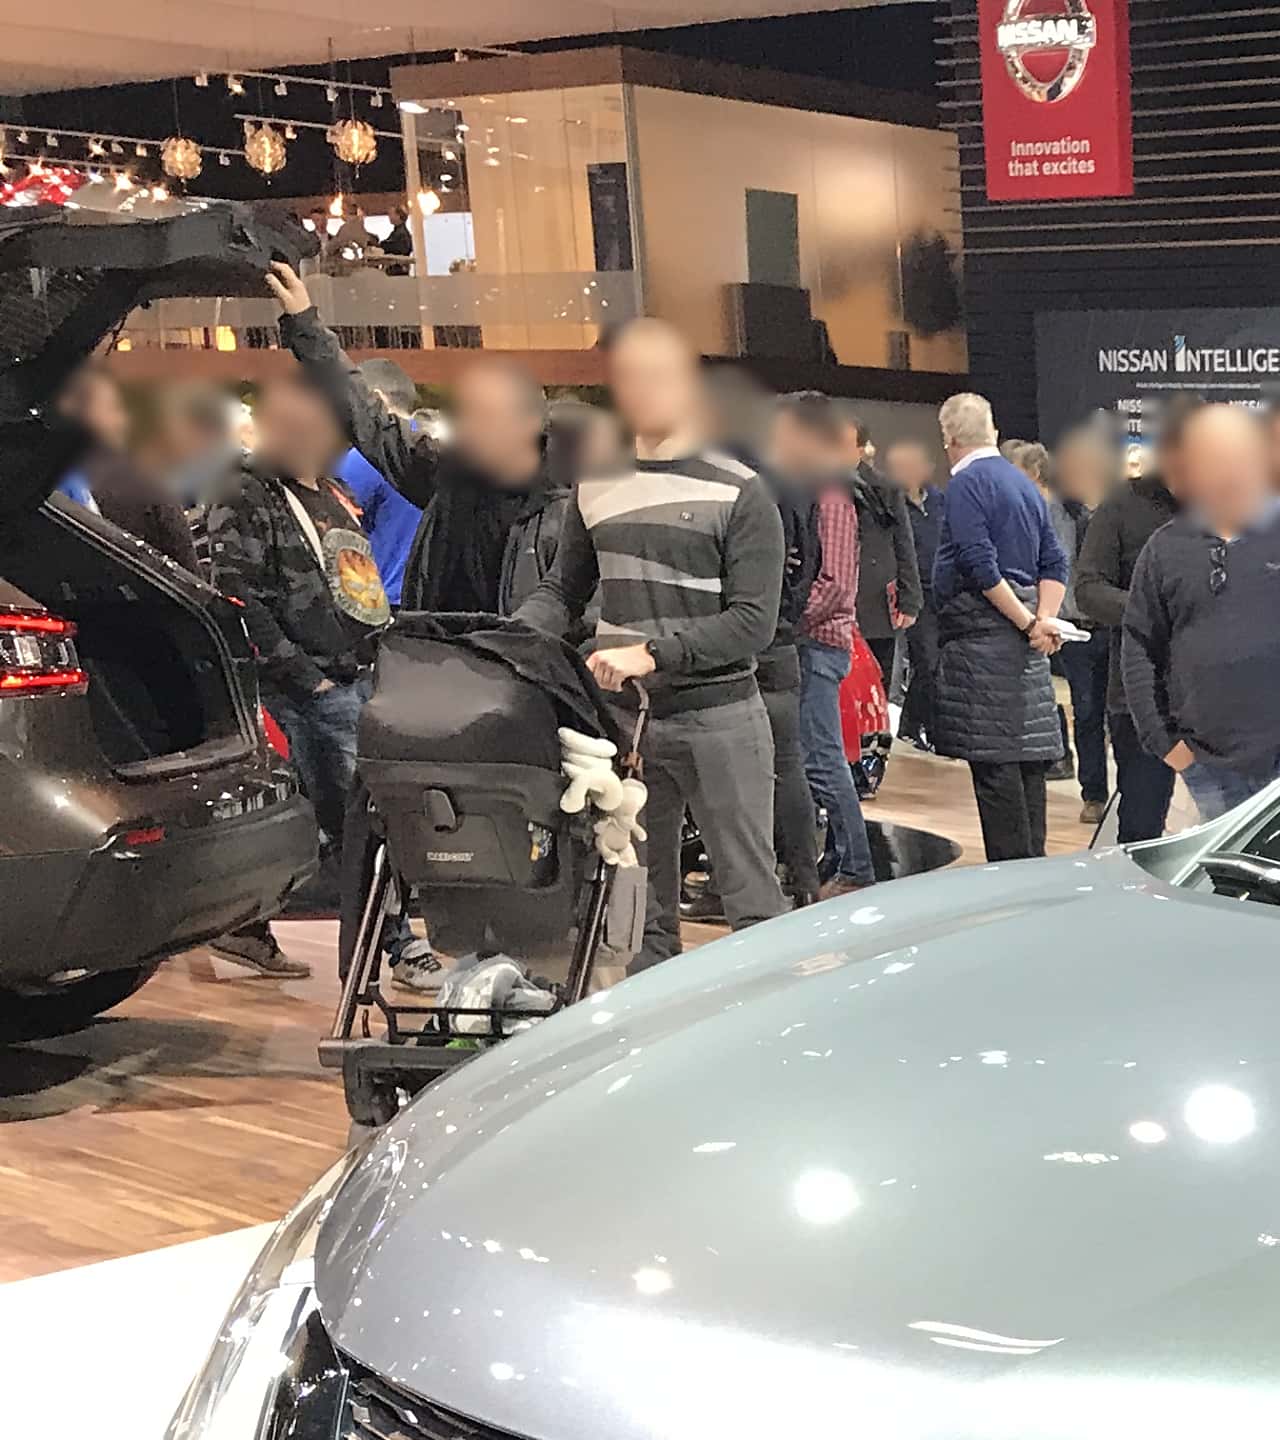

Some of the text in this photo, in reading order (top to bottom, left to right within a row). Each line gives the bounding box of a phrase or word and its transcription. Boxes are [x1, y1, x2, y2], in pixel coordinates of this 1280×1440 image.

[998, 19, 1079, 46] NISSAN
[1011, 136, 1090, 157] Innovation
[1008, 157, 1095, 177] that excites
[1099, 349, 1167, 372] NISSAN
